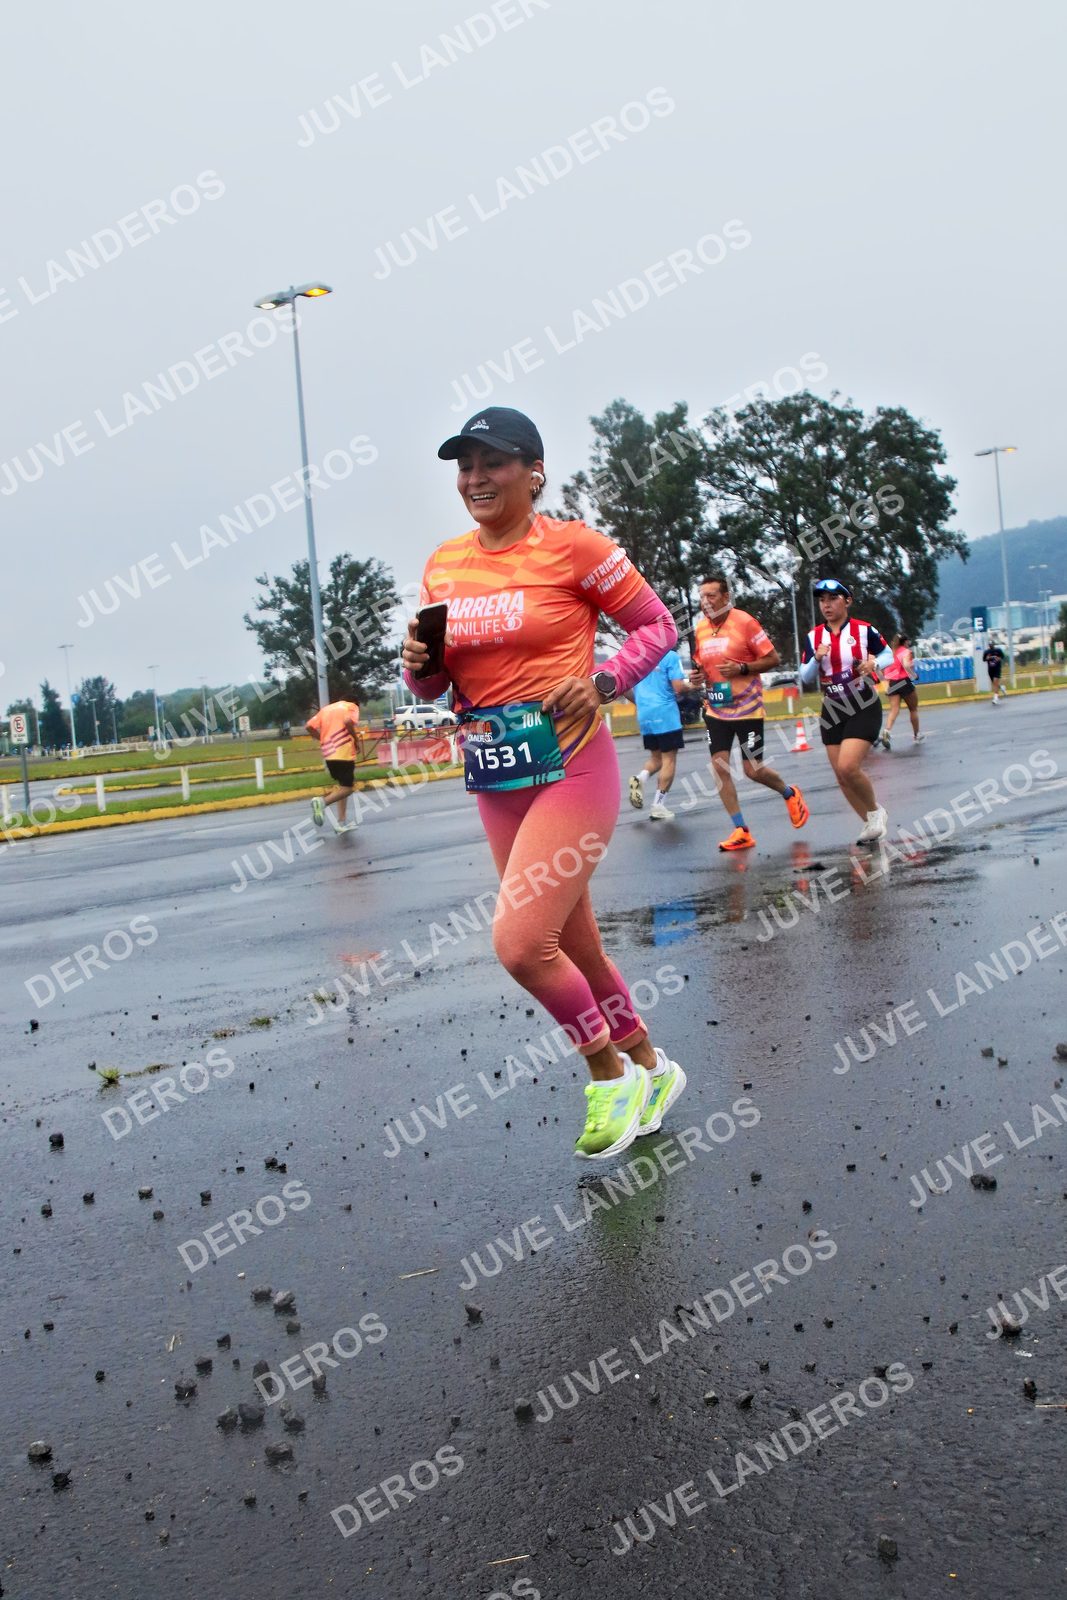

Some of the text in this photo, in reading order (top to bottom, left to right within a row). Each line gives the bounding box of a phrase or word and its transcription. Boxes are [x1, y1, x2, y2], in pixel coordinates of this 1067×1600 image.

[446, 619, 501, 636] MNILIFE
[973, 617, 984, 630] E
[522, 711, 542, 728] 10K
[475, 741, 532, 769] 1531
